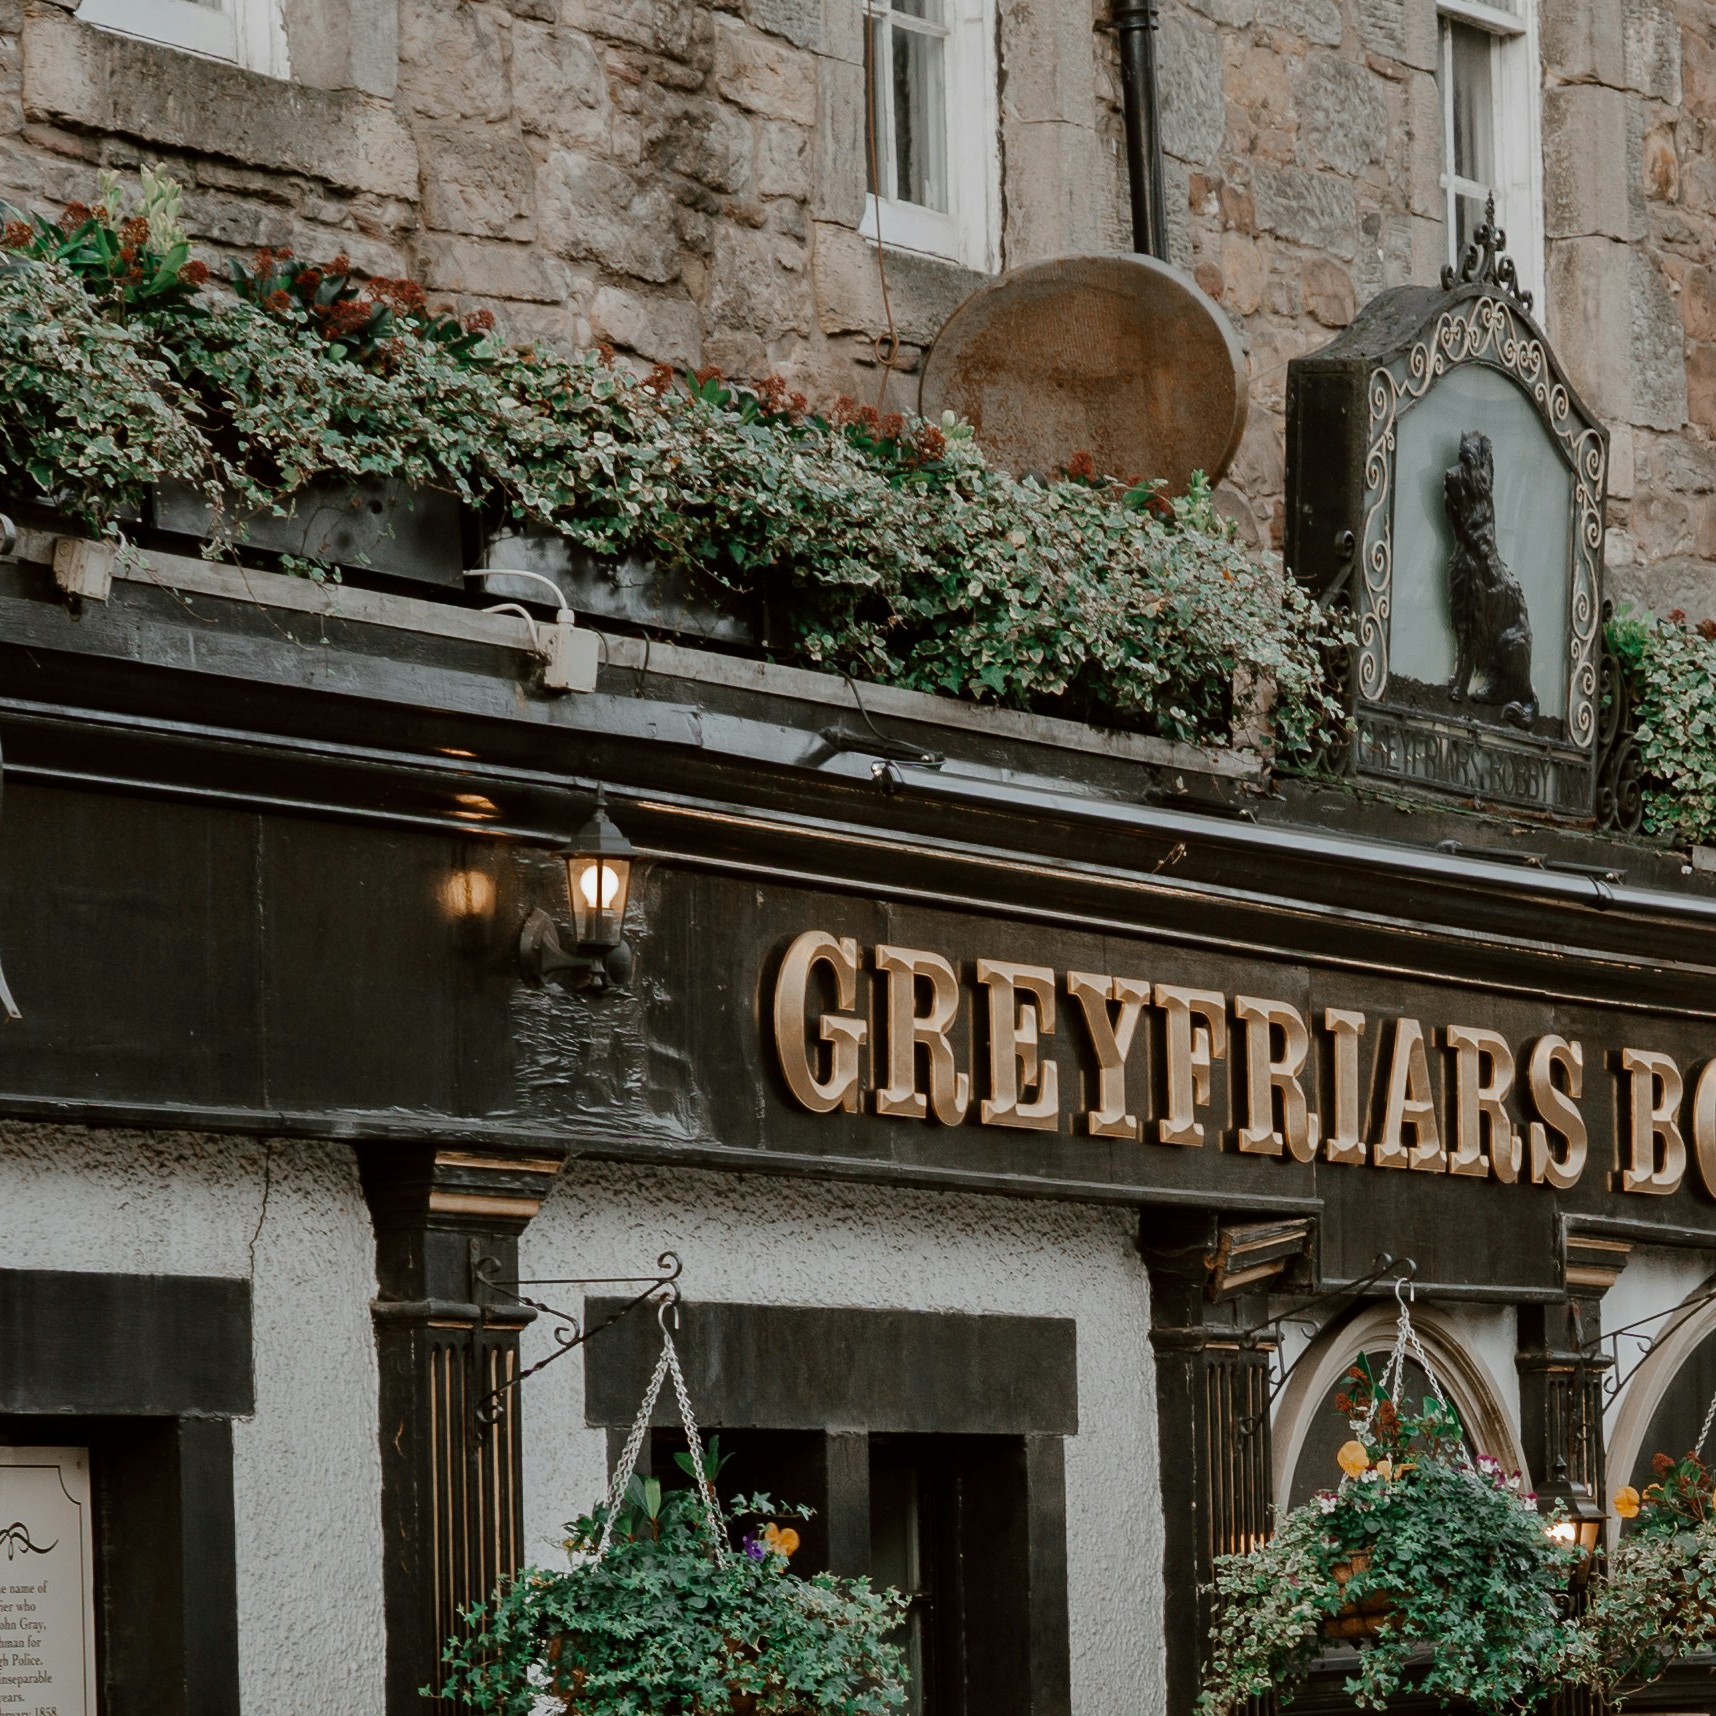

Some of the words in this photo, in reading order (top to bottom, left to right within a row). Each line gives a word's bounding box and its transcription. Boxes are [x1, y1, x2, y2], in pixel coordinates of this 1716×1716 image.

[772, 928, 1589, 1191] GREYFRIARS
[9, 1585, 36, 1594] name
[37, 1580, 48, 1593] of
[15, 1598, 36, 1612] who
[27, 1634, 42, 1648] for
